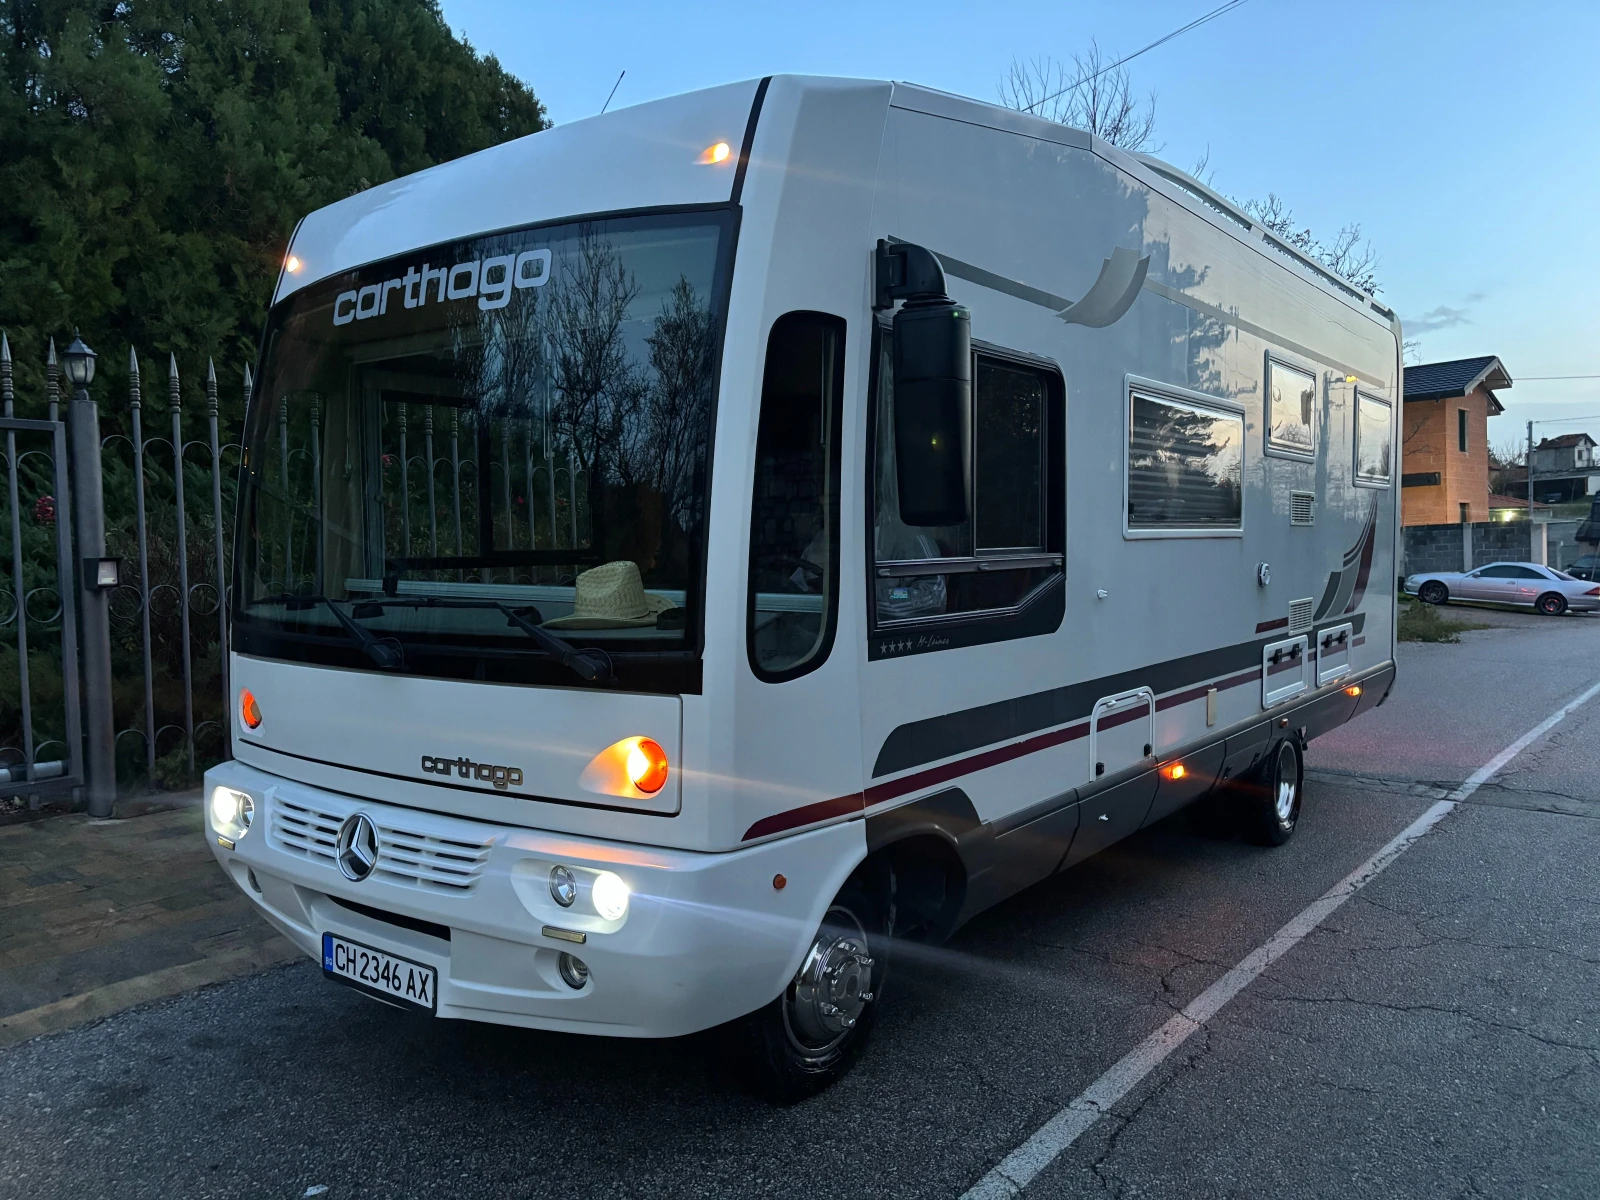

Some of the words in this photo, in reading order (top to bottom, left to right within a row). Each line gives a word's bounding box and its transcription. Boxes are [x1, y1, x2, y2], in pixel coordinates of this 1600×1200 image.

[333, 248, 552, 327] carthago
[421, 755, 524, 790] carthago
[325, 956, 333, 966] BG
[335, 943, 357, 976] CH
[360, 952, 402, 992] 2346
[405, 968, 430, 1003] AX
